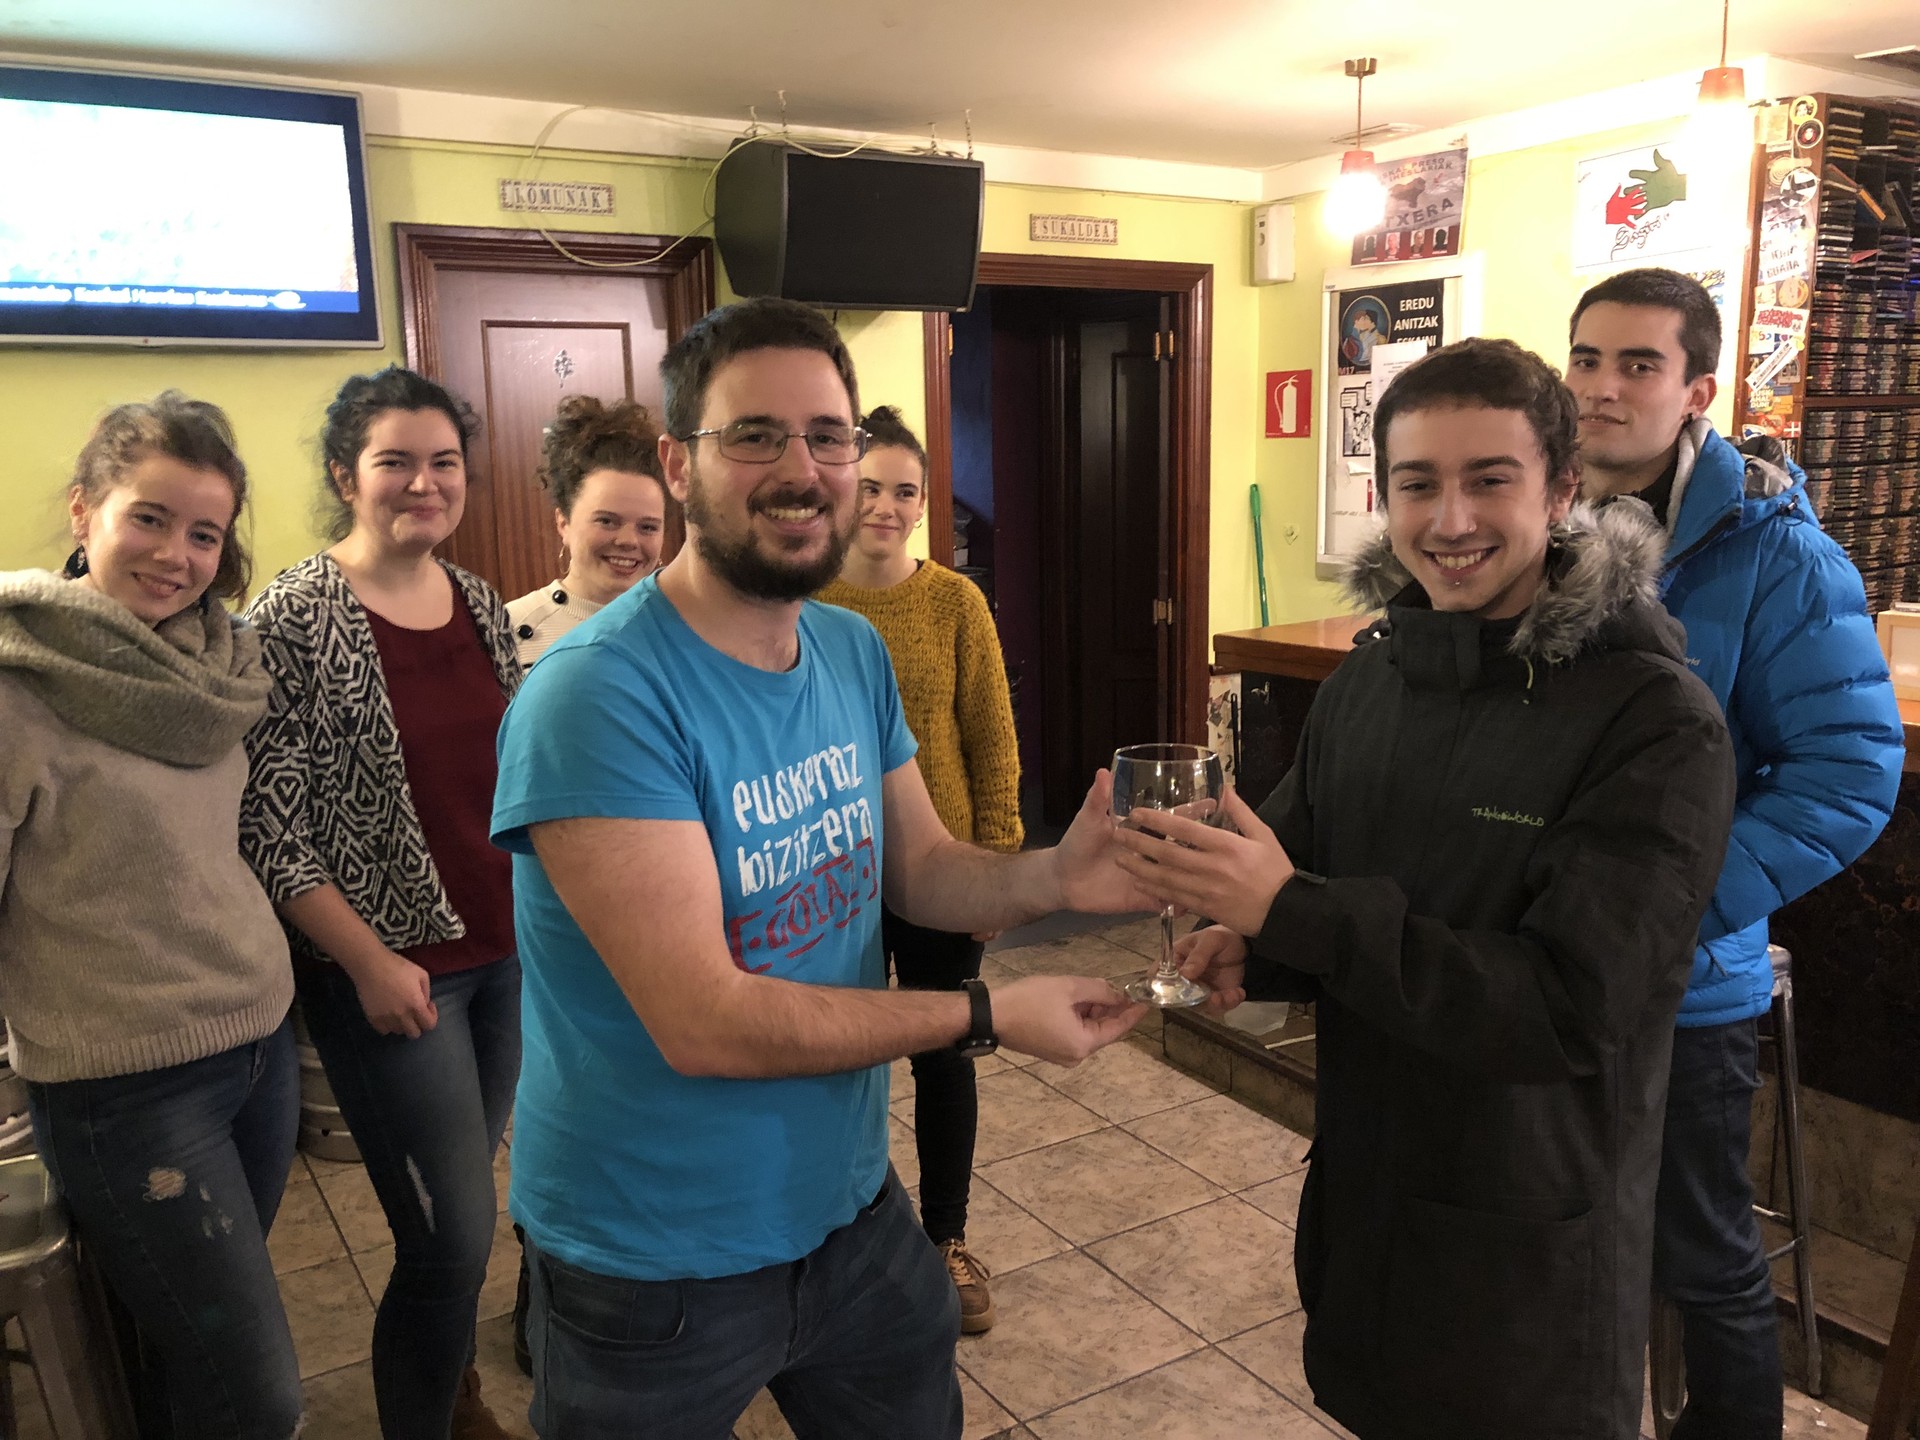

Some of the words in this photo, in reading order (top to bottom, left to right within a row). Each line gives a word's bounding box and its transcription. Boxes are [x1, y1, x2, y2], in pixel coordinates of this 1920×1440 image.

[1411, 158, 1445, 169] PRESO
[515, 187, 601, 208] KOMUNAK
[1385, 197, 1455, 228] TXERA
[1042, 220, 1109, 238] SUKALDEA
[1399, 296, 1435, 312] EREDU
[1393, 315, 1439, 331] ANITZAK
[737, 797, 873, 897] bizitzera
